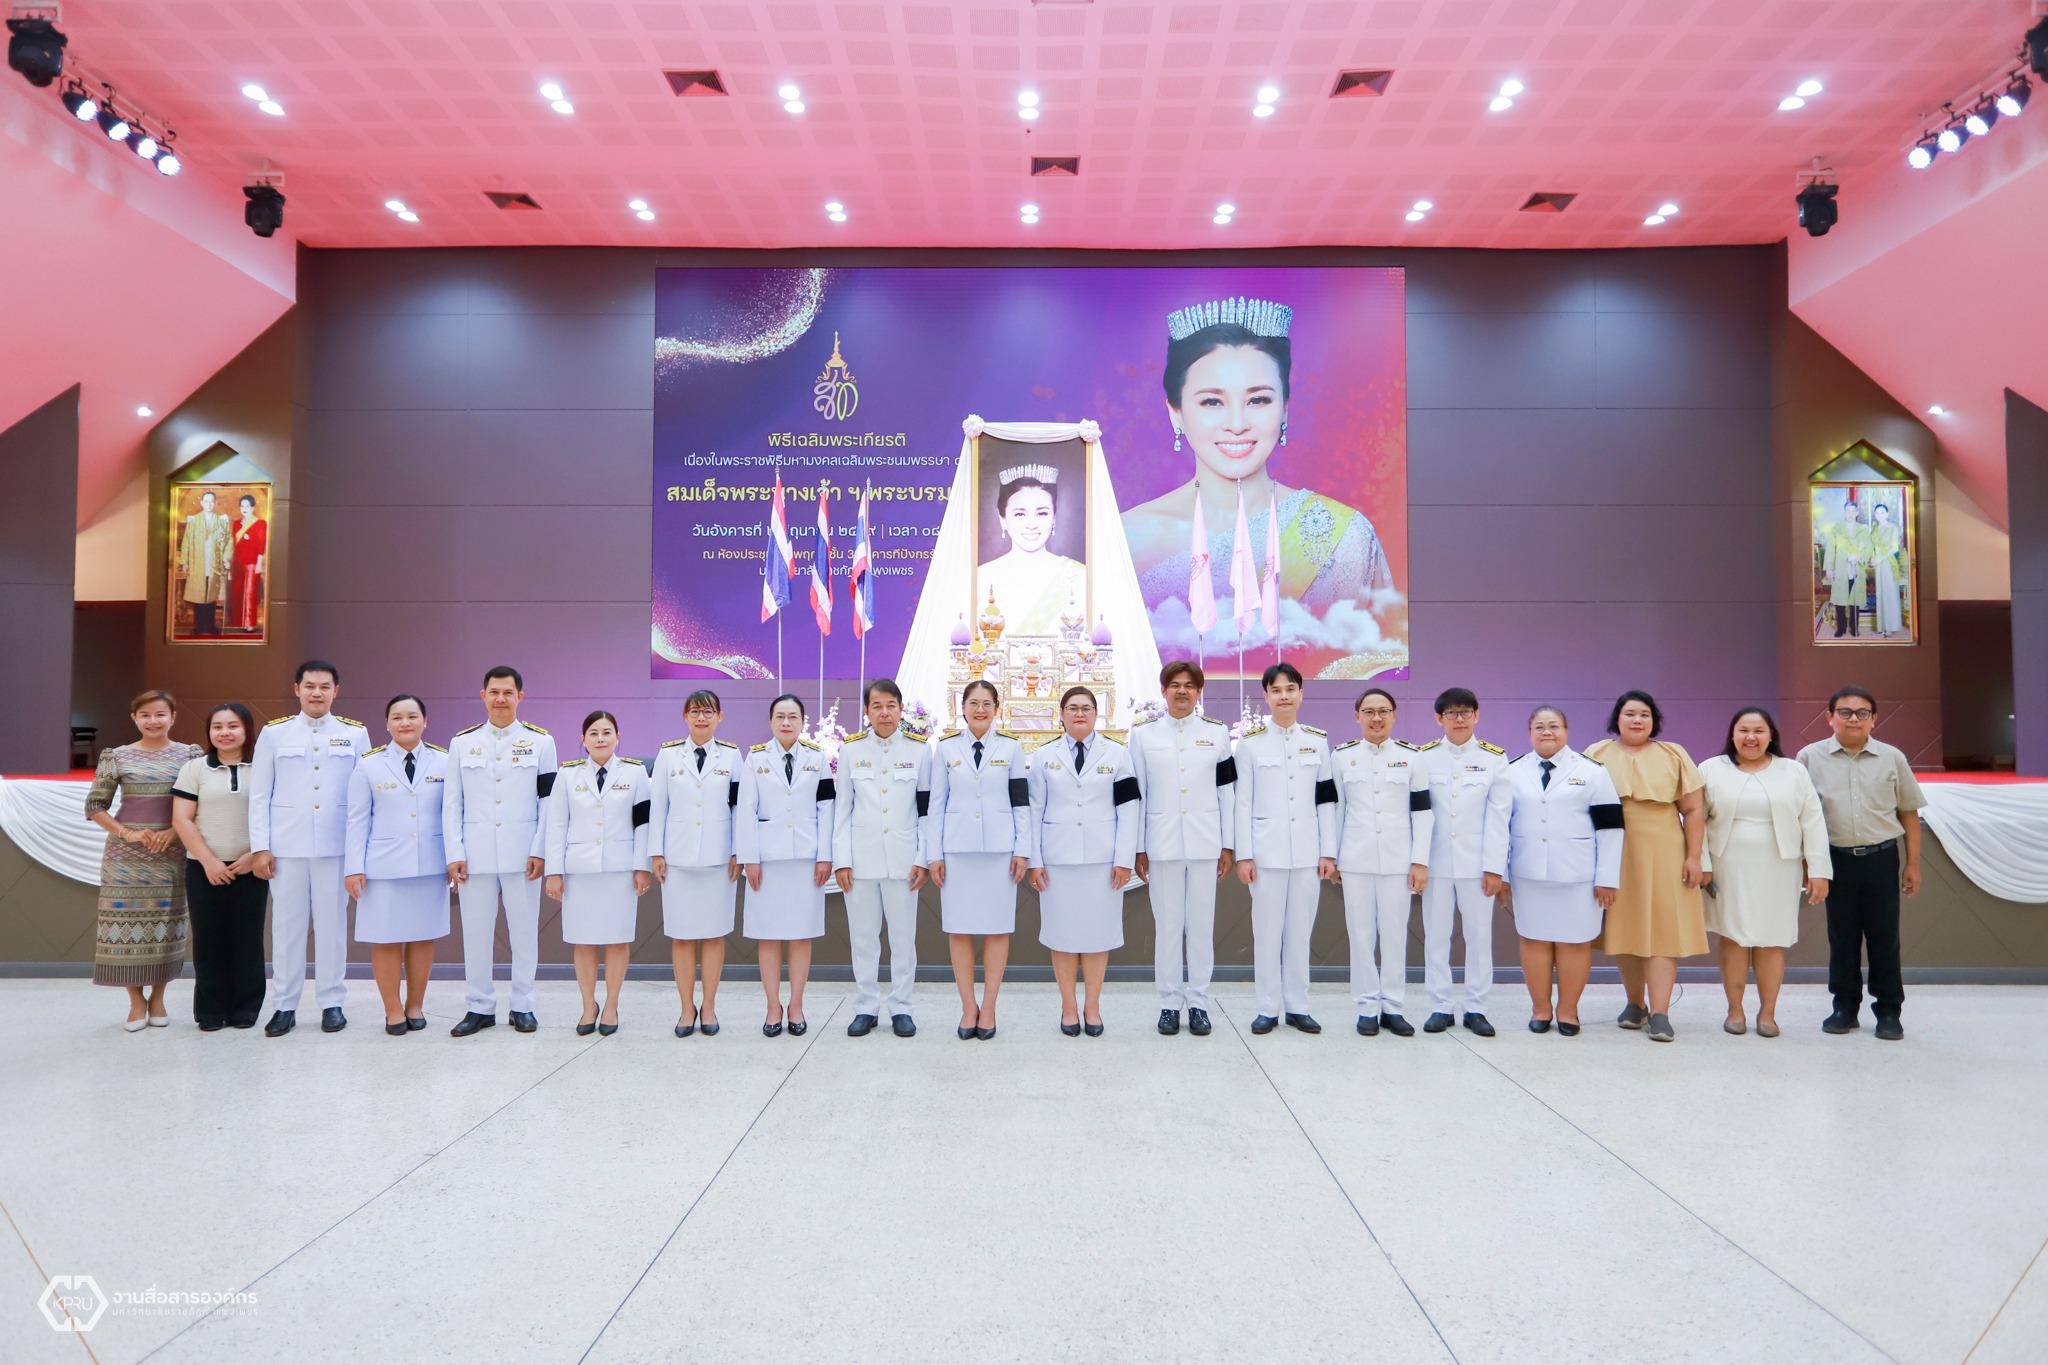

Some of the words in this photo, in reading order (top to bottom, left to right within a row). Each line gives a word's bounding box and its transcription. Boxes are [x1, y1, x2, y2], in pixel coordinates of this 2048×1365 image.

[768, 431, 906, 447] พิธีเฉลิมพระเกียรติ
[692, 521, 762, 537] วันอังคารที่
[888, 525, 918, 537] เวลา
